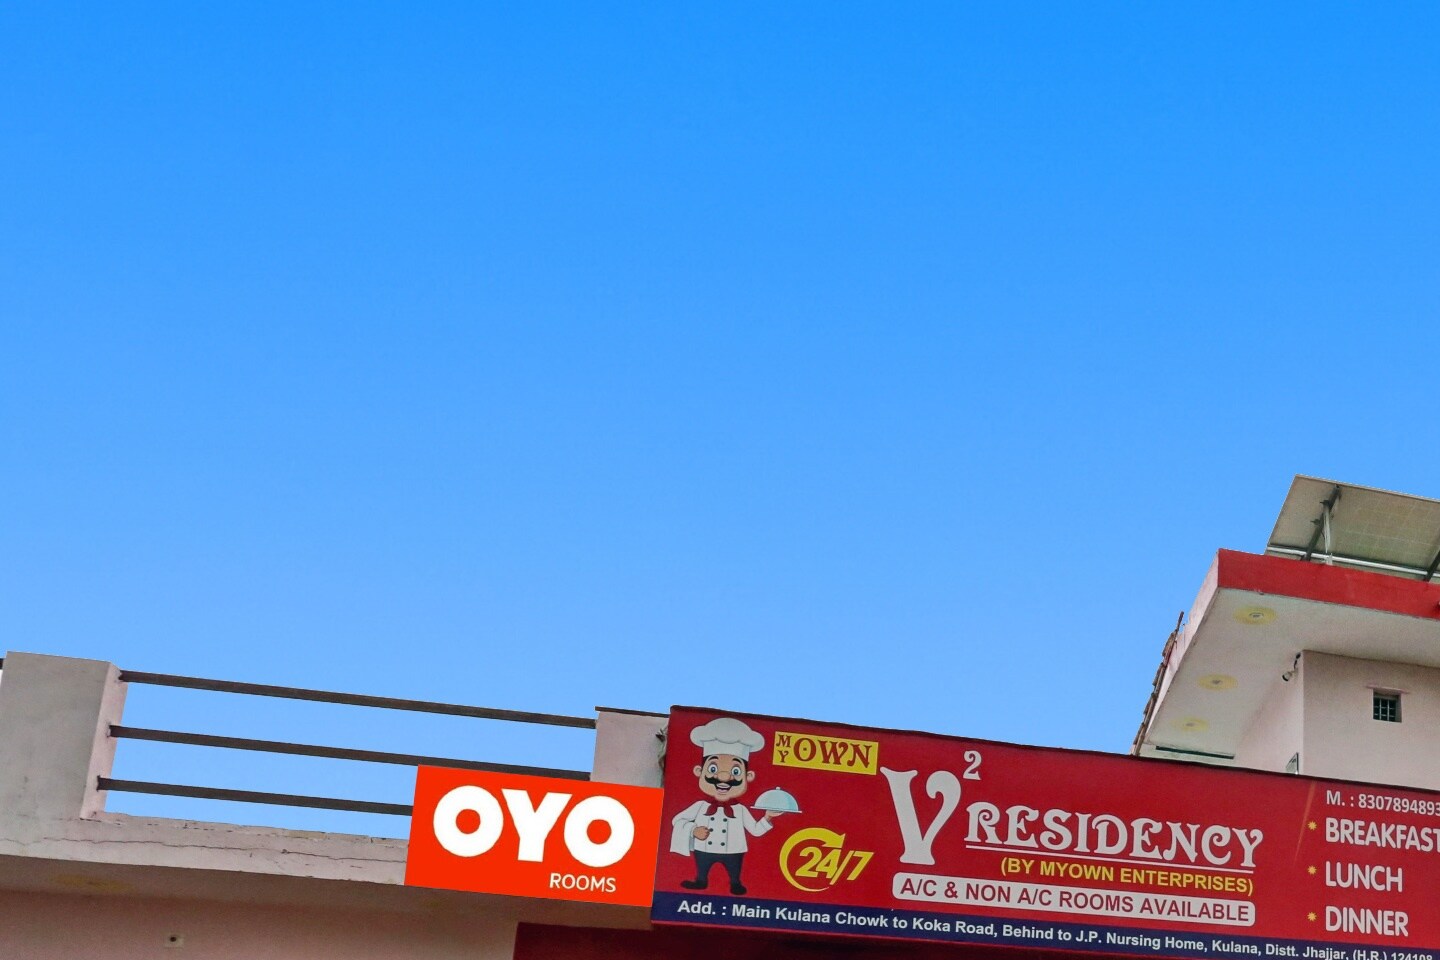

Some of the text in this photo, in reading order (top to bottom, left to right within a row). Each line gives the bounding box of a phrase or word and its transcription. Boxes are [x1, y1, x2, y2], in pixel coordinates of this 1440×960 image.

[793, 737, 872, 768] OWN
[880, 750, 982, 866] V 2
[1326, 790, 1345, 806] M.
[433, 785, 635, 867] OYO
[964, 801, 1264, 867] RESIDENCY
[549, 872, 617, 893] ROOMS
[796, 846, 874, 884] 24/7
[1001, 857, 1254, 896] (BY MYOWN ENTERPRISES)
[1325, 862, 1402, 892] LUNCH
[900, 878, 1249, 922] A/C & NON A/C ROOMS AVAILABLE
[677, 900, 716, 915] Add.
[732, 904, 770, 918] Main
[775, 907, 830, 923] Kulana
[835, 912, 888, 927] Chowk
[892, 916, 908, 929] to
[912, 917, 951, 932] Koka
[955, 921, 998, 937] Road,
[1002, 924, 1054, 940] Behind
[1058, 929, 1072, 941] to
[1076, 930, 1102, 943] J.P.
[1106, 932, 1161, 950] Nursing
[1165, 937, 1208, 952] Home,
[1212, 939, 1261, 956] Kulana,
[1265, 943, 1299, 957] Distt.
[1324, 906, 1409, 937] DINNER
